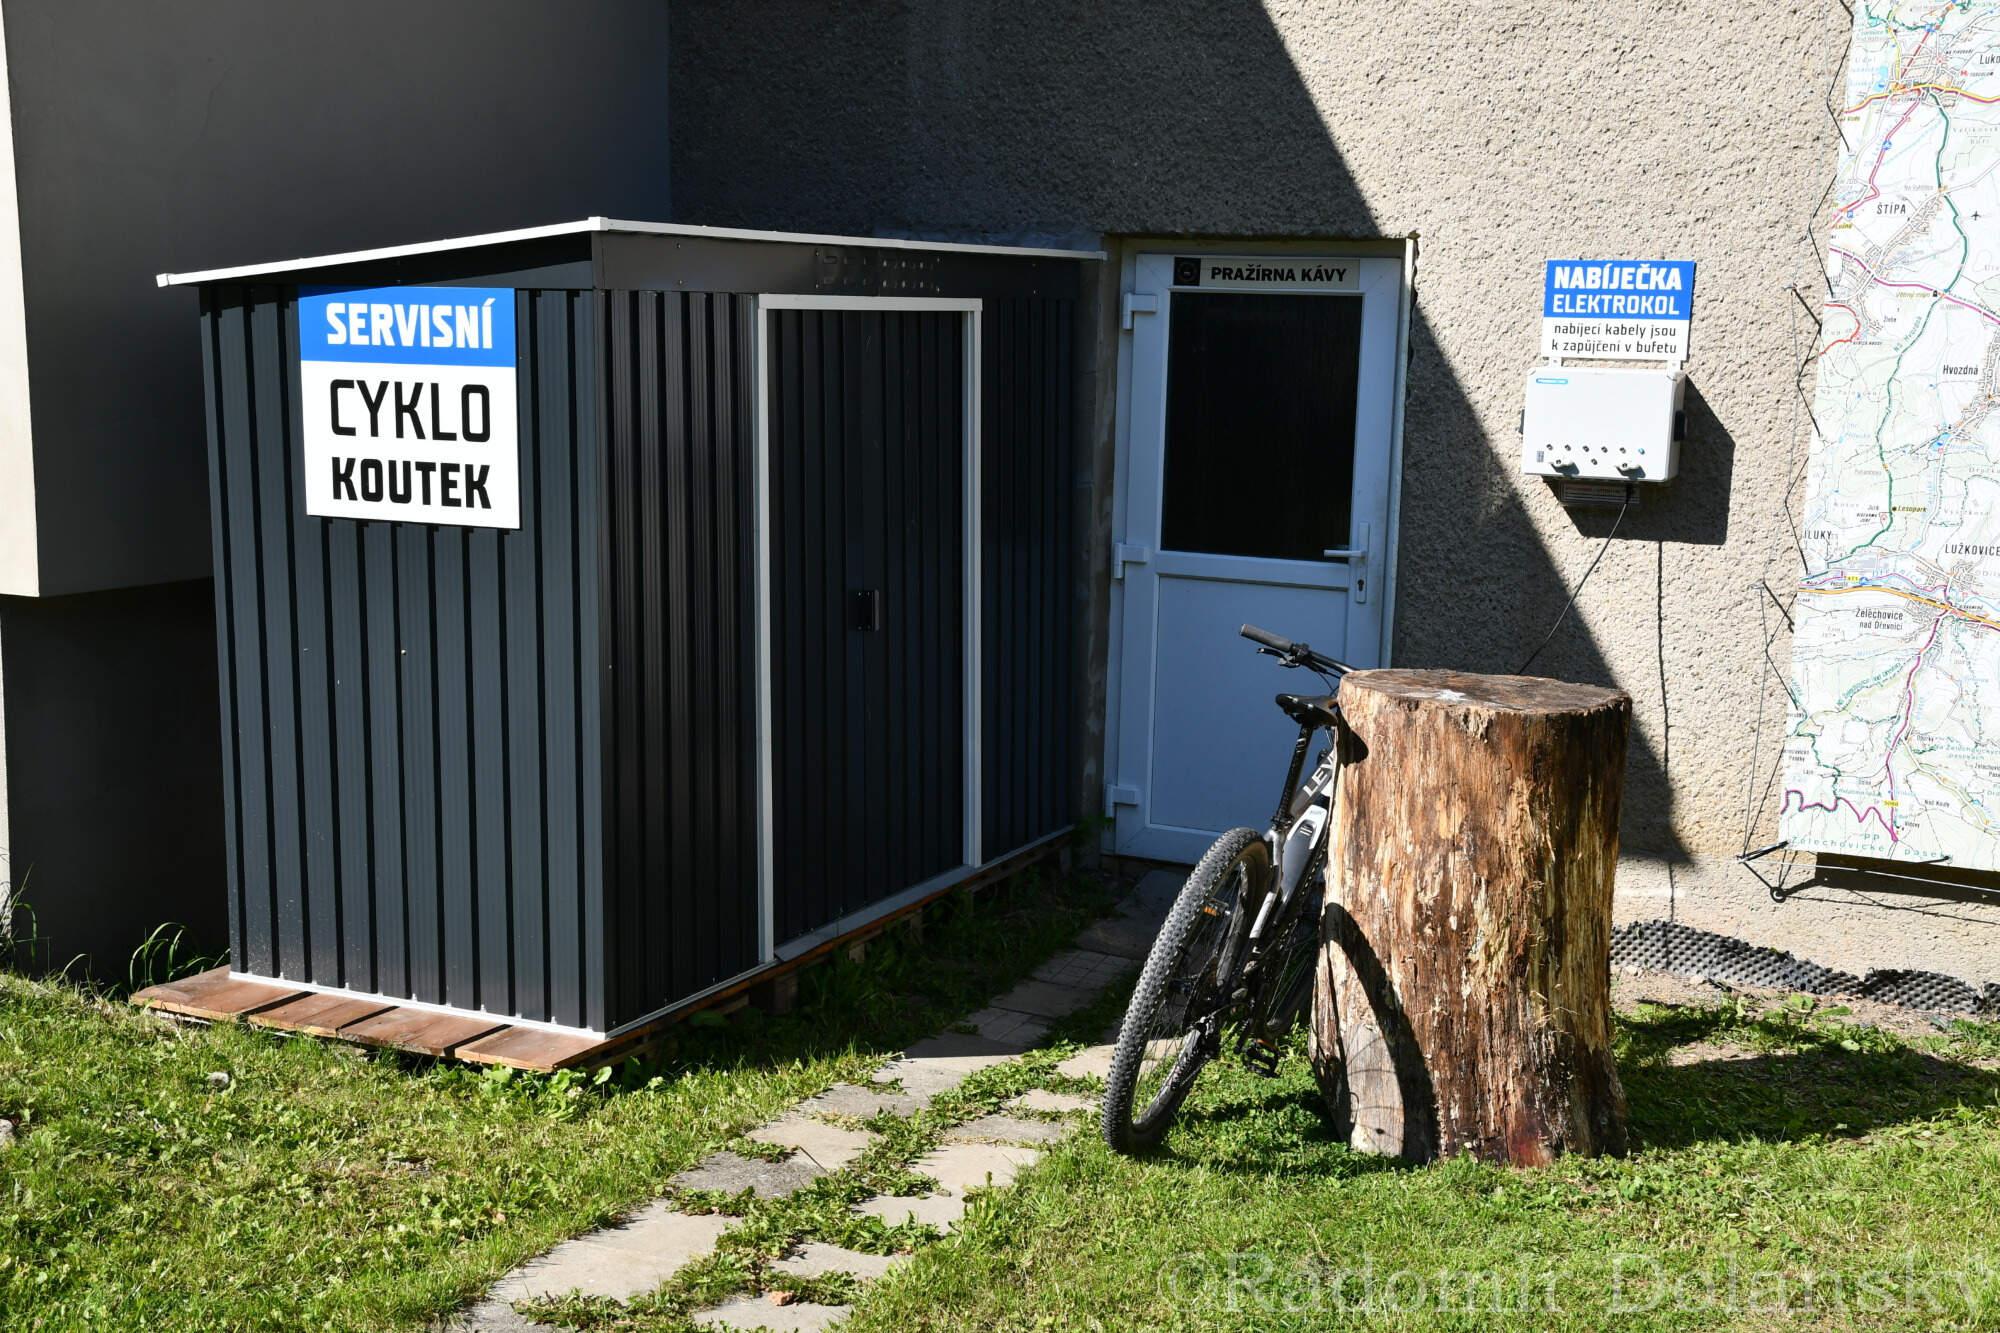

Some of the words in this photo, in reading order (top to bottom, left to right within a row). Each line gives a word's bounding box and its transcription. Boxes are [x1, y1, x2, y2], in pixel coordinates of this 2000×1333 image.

[1876, 201, 1907, 215] ŠTÍPA
[1210, 263, 1296, 282] PRAŽÍRNA
[1301, 264, 1347, 282] KÁVY
[1553, 263, 1682, 290] NABÍJEČKA
[1552, 293, 1680, 315] ELEKTROKOL
[326, 297, 496, 349] SERVISNÍ
[1554, 323, 1601, 337] nabíjecí
[1605, 323, 1647, 338] kabely
[1650, 324, 1677, 339] jsou
[1551, 339, 1559, 351] k
[1562, 339, 1622, 354] zapůjčení
[1624, 343, 1632, 353] v
[1636, 340, 1678, 354] bufetu
[1942, 363, 1979, 376] Hvozdná
[330, 378, 491, 443] CYKLO
[331, 456, 492, 510] KOUTEK
[1859, 620, 1872, 630] nad
